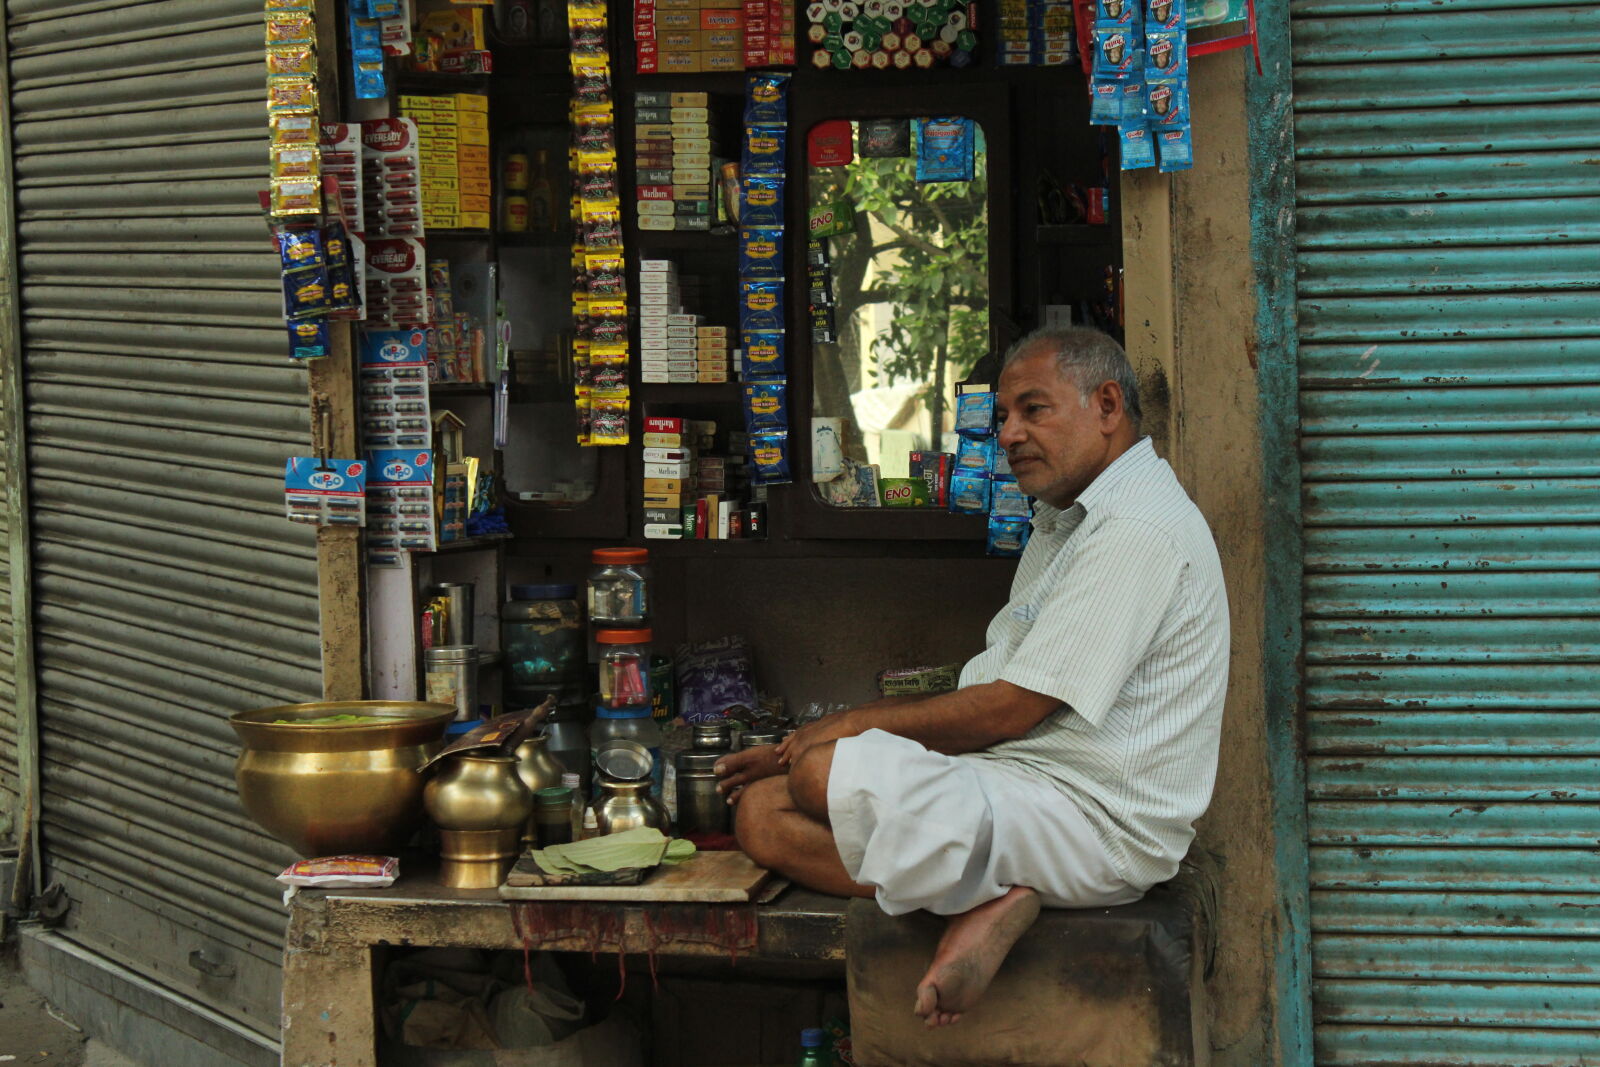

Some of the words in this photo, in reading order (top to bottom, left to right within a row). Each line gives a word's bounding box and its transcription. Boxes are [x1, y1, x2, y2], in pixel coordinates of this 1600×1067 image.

[364, 131, 402, 144] EVEREADY
[643, 186, 668, 198] Marlboro
[809, 212, 833, 230] ENO
[371, 253, 408, 265] EVEREADY
[383, 346, 407, 359] NIPPO
[649, 419, 674, 431] Marlboro
[386, 465, 411, 479] NIPPO
[312, 474, 342, 488] NIPPO
[885, 487, 911, 500] ENO
